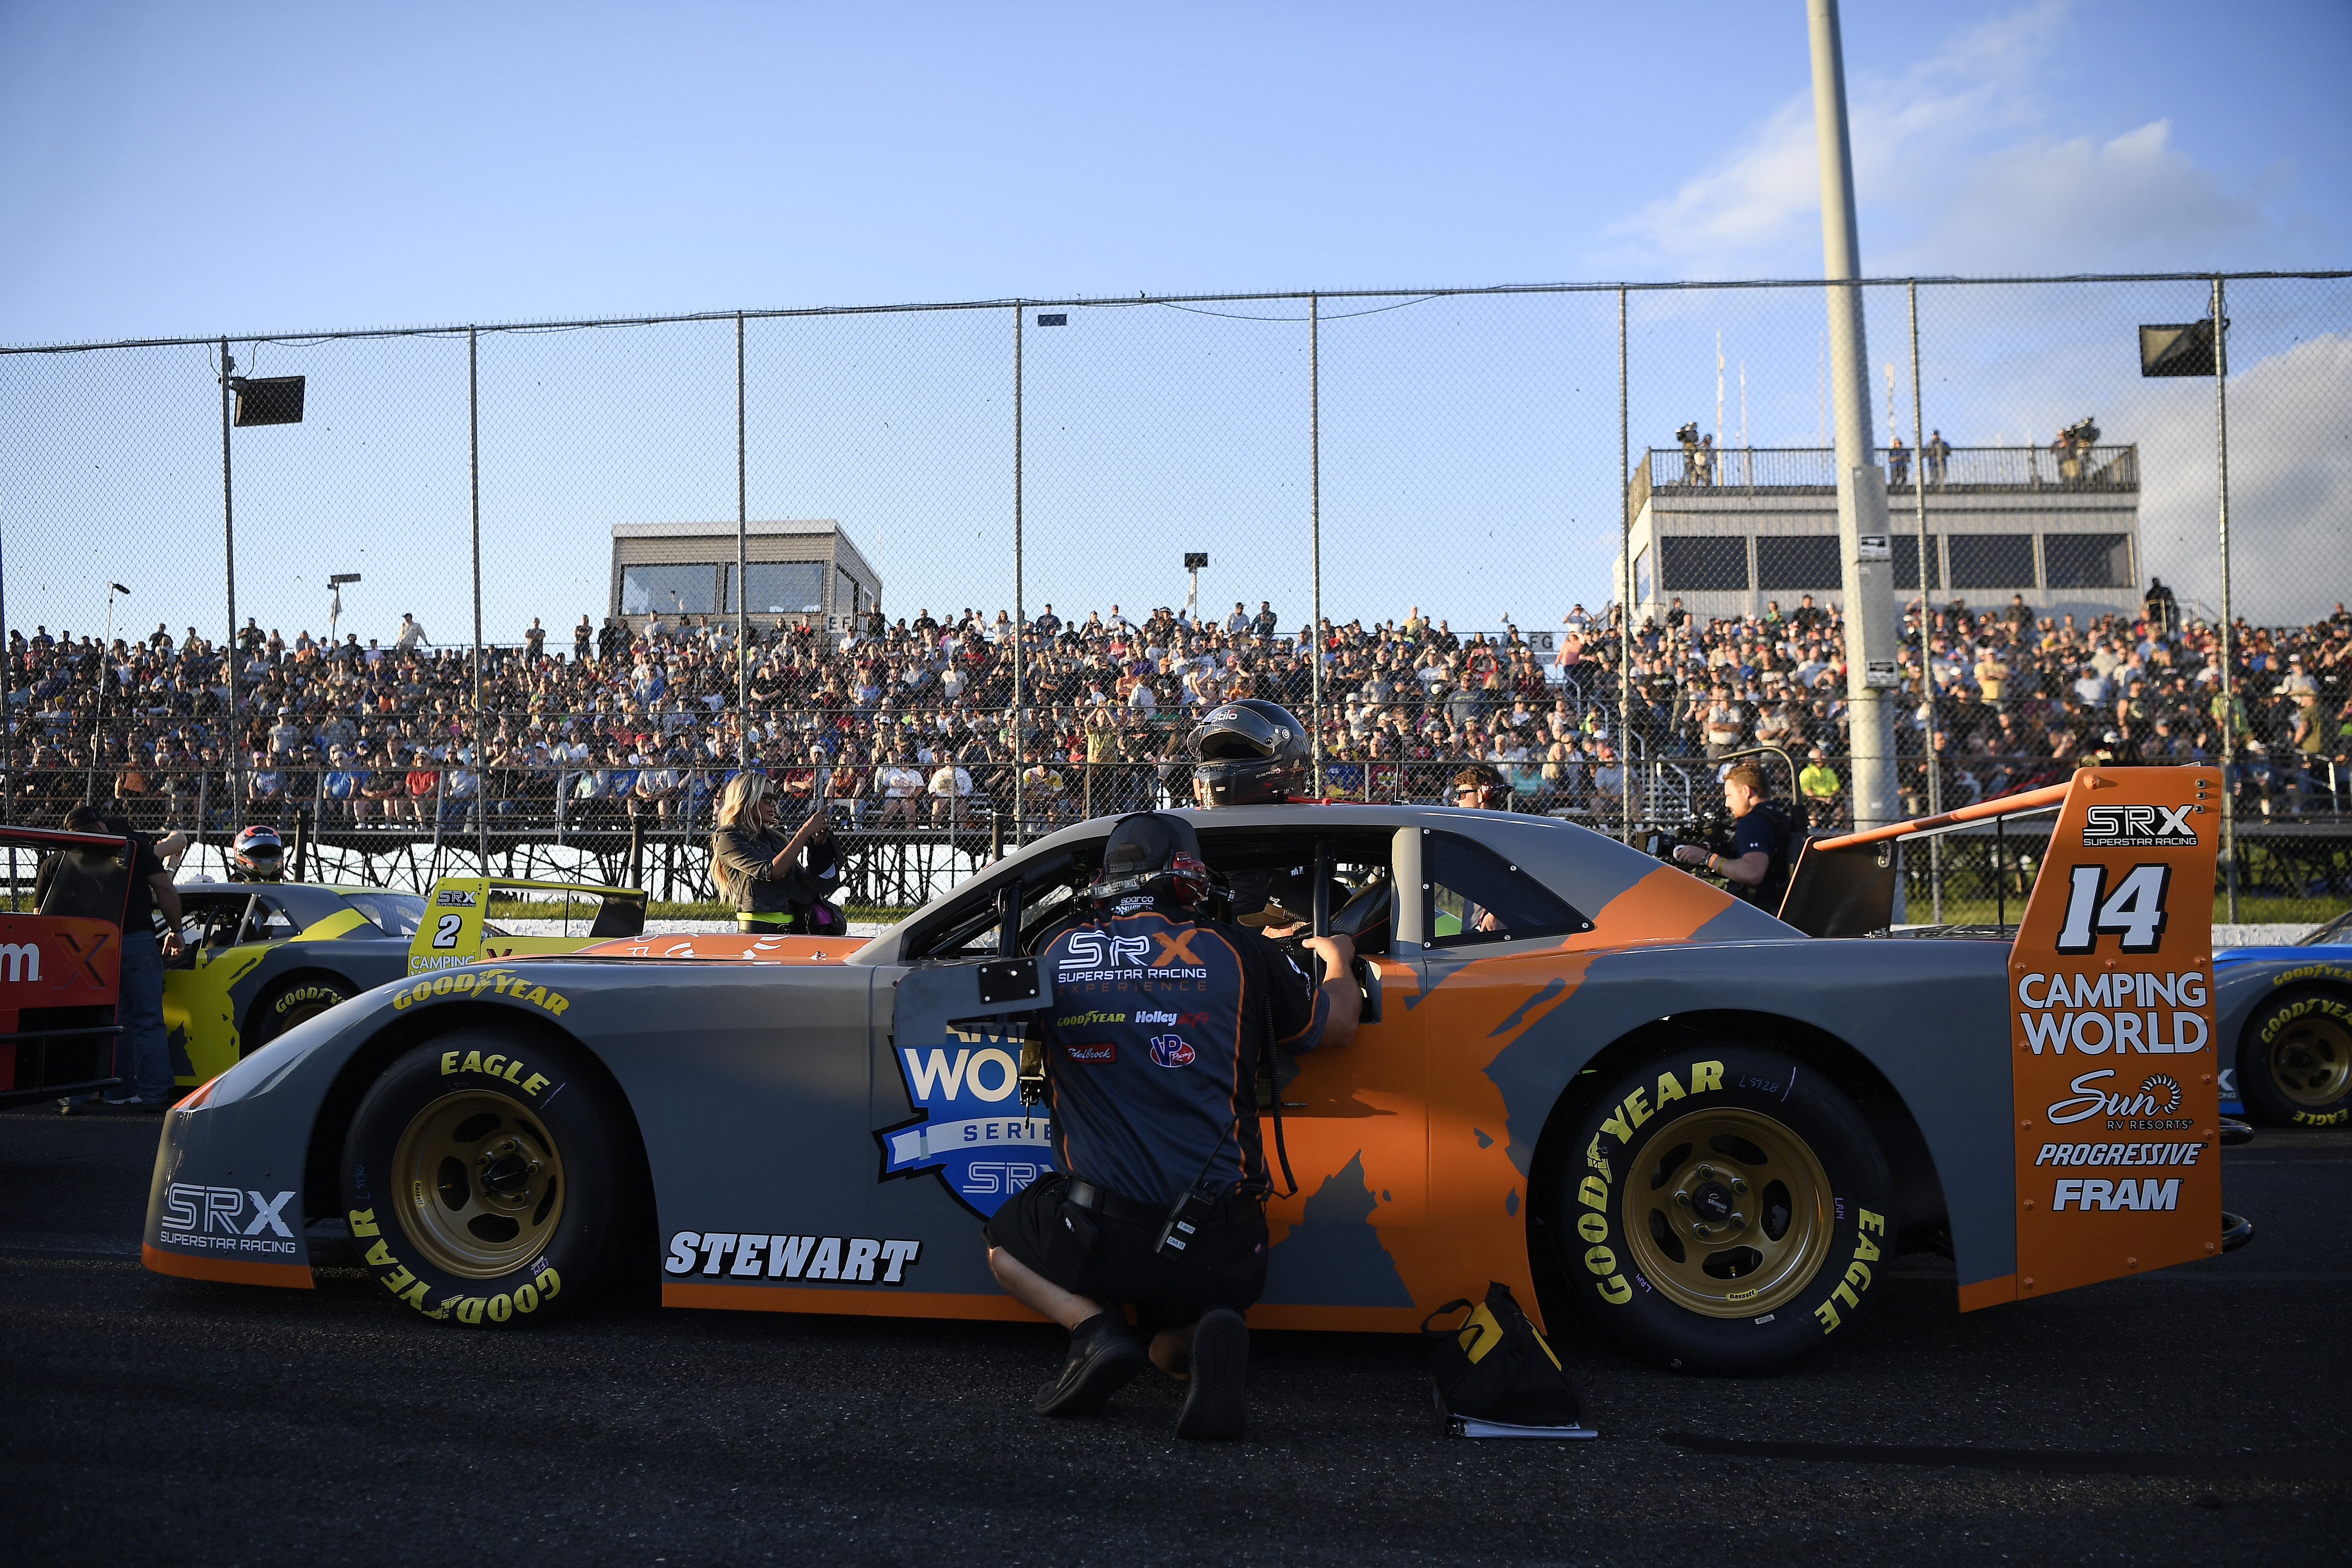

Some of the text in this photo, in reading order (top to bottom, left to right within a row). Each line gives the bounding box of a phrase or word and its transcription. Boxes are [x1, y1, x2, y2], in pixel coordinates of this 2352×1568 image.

[2083, 806, 2196, 836] SRX
[437, 891, 476, 903] SRX
[1120, 896, 1154, 906] sparco
[2058, 865, 2168, 950] 14
[433, 914, 462, 948] 2
[1059, 929, 1204, 970] SRX
[392, 968, 570, 1016] GOODYEAR
[1058, 968, 1207, 983] SUPERSTAR RACING
[1059, 981, 1206, 995] EXPERIENCE
[2019, 972, 2207, 1009] CAMPING
[1057, 1010, 1127, 1026] GOODYEAR
[1135, 1011, 1177, 1026] Holley
[1068, 1047, 1111, 1059] Edelbrock
[1150, 1034, 1183, 1067] VP
[440, 1050, 550, 1096] EAGLE
[2047, 1068, 2161, 1125] Sun
[2107, 1120, 2124, 1130] RV
[2293, 1108, 2349, 1126] EAGLE
[2035, 1143, 2202, 1166] PROGRESSIVE
[1577, 1060, 1724, 1305] GOODYEAR
[2052, 1178, 2180, 1211] FRAM
[161, 1183, 296, 1238] SRX
[160, 1231, 296, 1253] SUPERSTAR RACING
[665, 1230, 921, 1282] STEWART
[349, 1208, 561, 1323] GOODYEAR
[1814, 1208, 1884, 1335] EAGLE
[1729, 1290, 1755, 1299] Bassett
